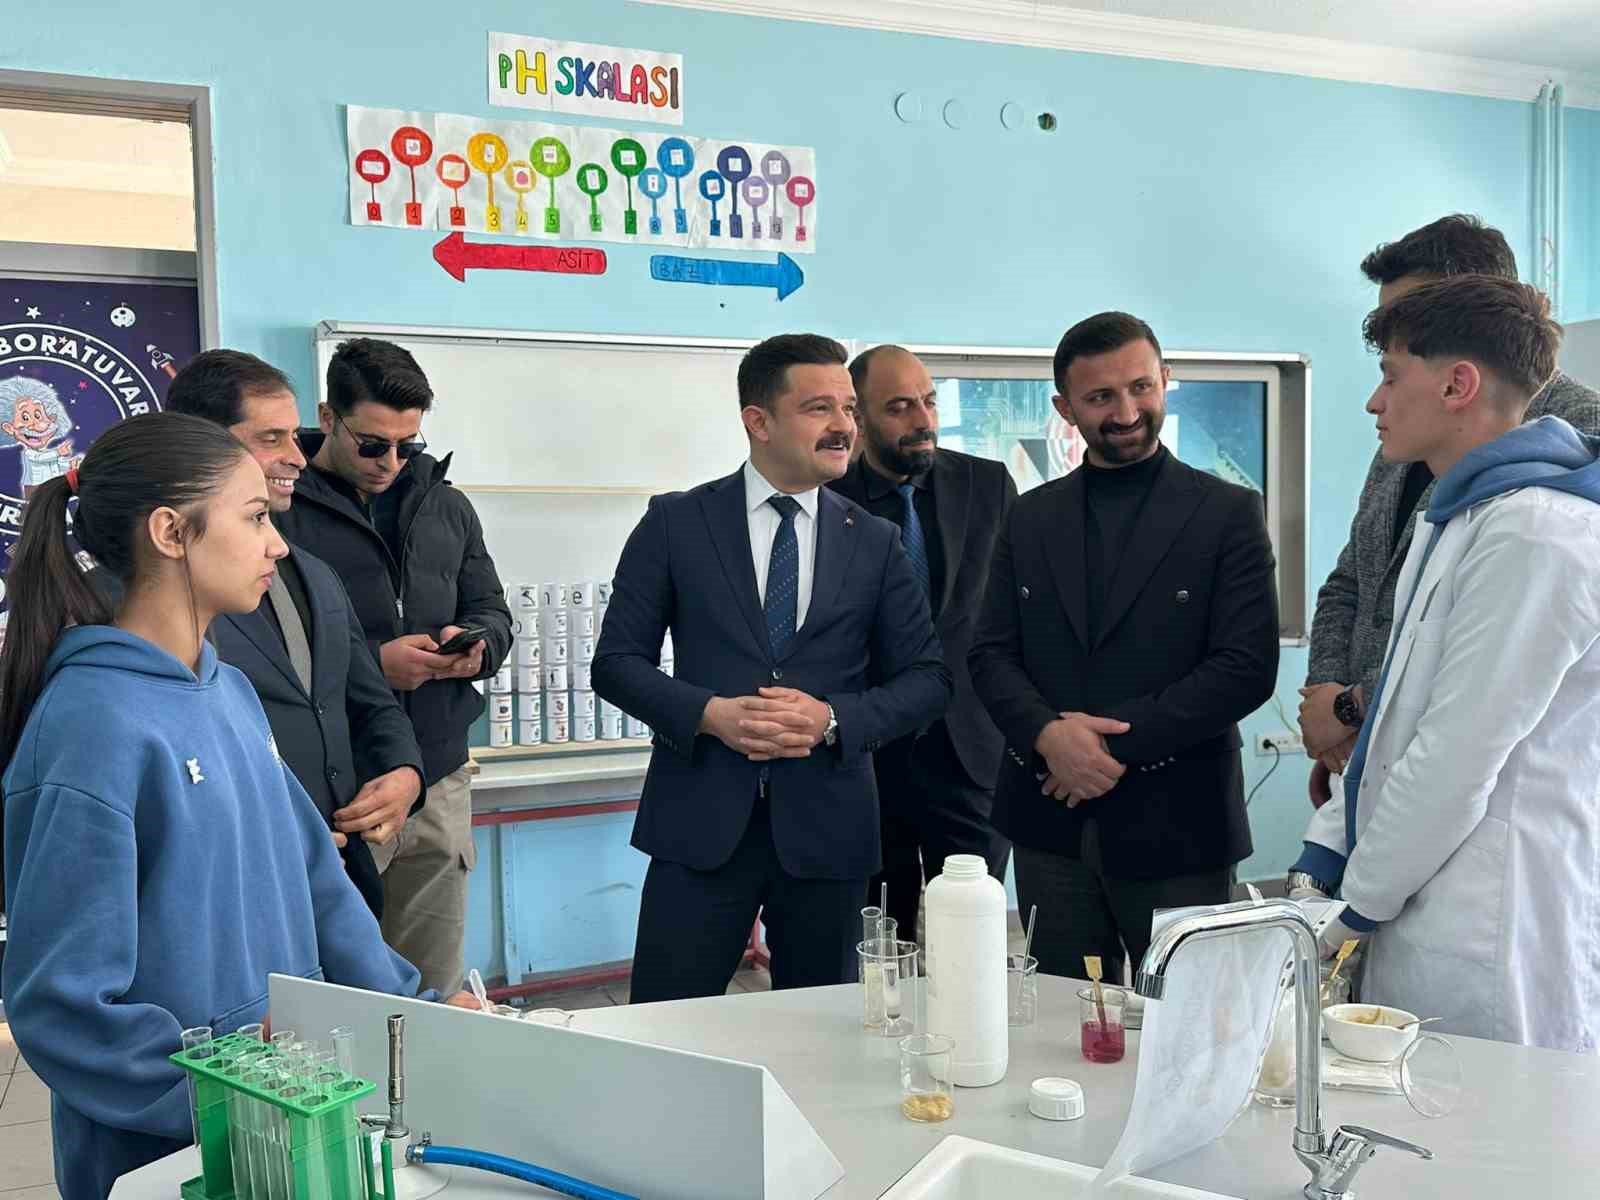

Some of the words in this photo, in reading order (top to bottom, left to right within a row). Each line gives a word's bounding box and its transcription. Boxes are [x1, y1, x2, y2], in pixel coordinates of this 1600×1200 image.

[555, 56, 680, 109] SKALASI
[410, 206, 418, 218] 1
[454, 207, 462, 220] 2
[490, 211, 498, 227] 3
[549, 213, 556, 226] 5
